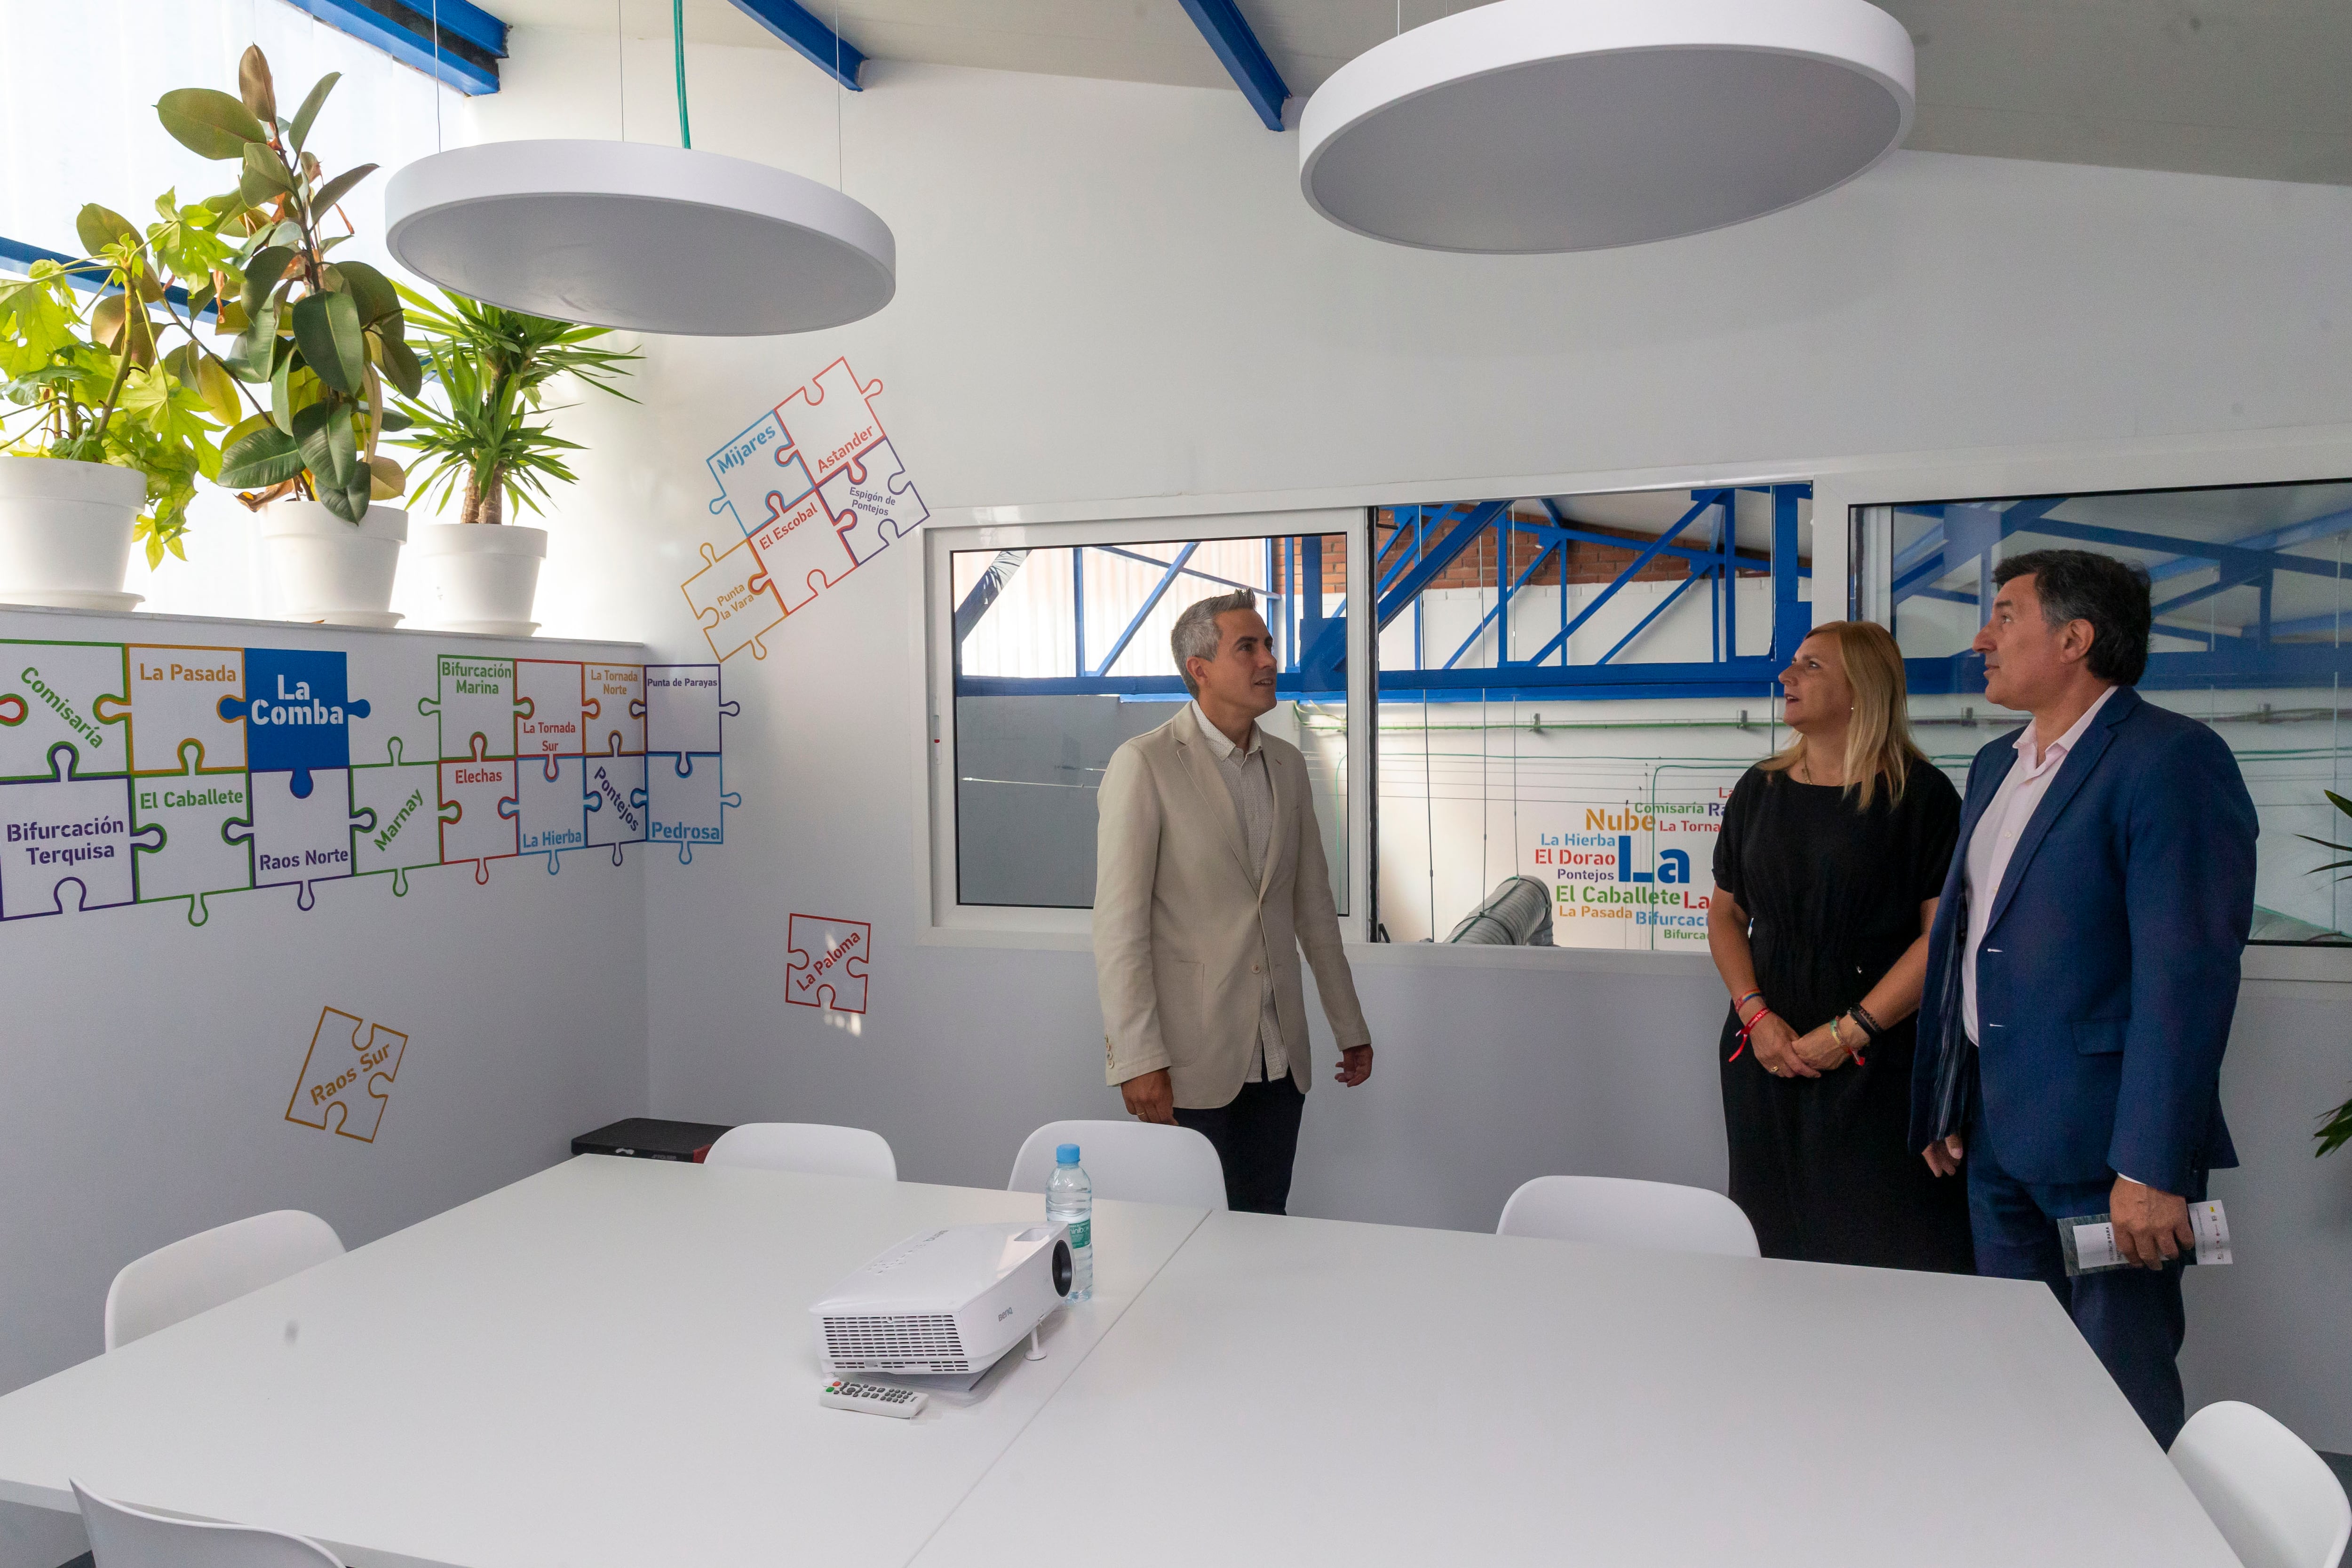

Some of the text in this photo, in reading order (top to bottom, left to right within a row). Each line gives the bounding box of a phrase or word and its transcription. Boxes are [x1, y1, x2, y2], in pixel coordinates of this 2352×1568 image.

[716, 425, 776, 474] Mijares
[818, 425, 873, 474] Astander
[850, 486, 896, 506] Espigón de
[851, 499, 889, 516] Pontejos
[759, 502, 818, 550] El Escobal
[716, 583, 745, 607] Punta
[720, 595, 754, 621] la Vara
[141, 663, 236, 682] La Pasada
[442, 661, 512, 678] Bifurcación
[591, 669, 638, 682] La Tornada
[278, 675, 310, 700] La
[456, 680, 499, 694] Marina
[604, 685, 627, 695] Norte
[684, 678, 717, 688] Parayas
[21, 667, 103, 749] Comisaría
[251, 699, 344, 725] Comba
[523, 722, 576, 734] La Tornada
[542, 740, 558, 751] Sur
[455, 770, 502, 784] Elechas
[141, 789, 243, 809] El Caballete
[594, 766, 639, 832] Pontejos
[1635, 802, 1704, 814] Comisaría
[7, 816, 124, 842] Bifurcación
[374, 789, 423, 852] Marnay
[1586, 808, 1656, 832] Nube
[1660, 820, 1676, 831] La
[523, 829, 581, 848] La Hierba
[652, 821, 720, 840] Pedrosa
[1541, 833, 1615, 846] La Hierba
[26, 843, 115, 866] Terquisa
[260, 848, 349, 870] Raos Norte
[1535, 849, 1615, 865] El Dorao
[1619, 835, 1690, 883] La
[1557, 869, 1614, 883] Pontejos
[1557, 885, 1681, 905] El Caballete
[1559, 905, 1632, 918] La Pasada
[796, 932, 861, 991] La Paloma
[310, 1043, 390, 1106] Raos Sur
